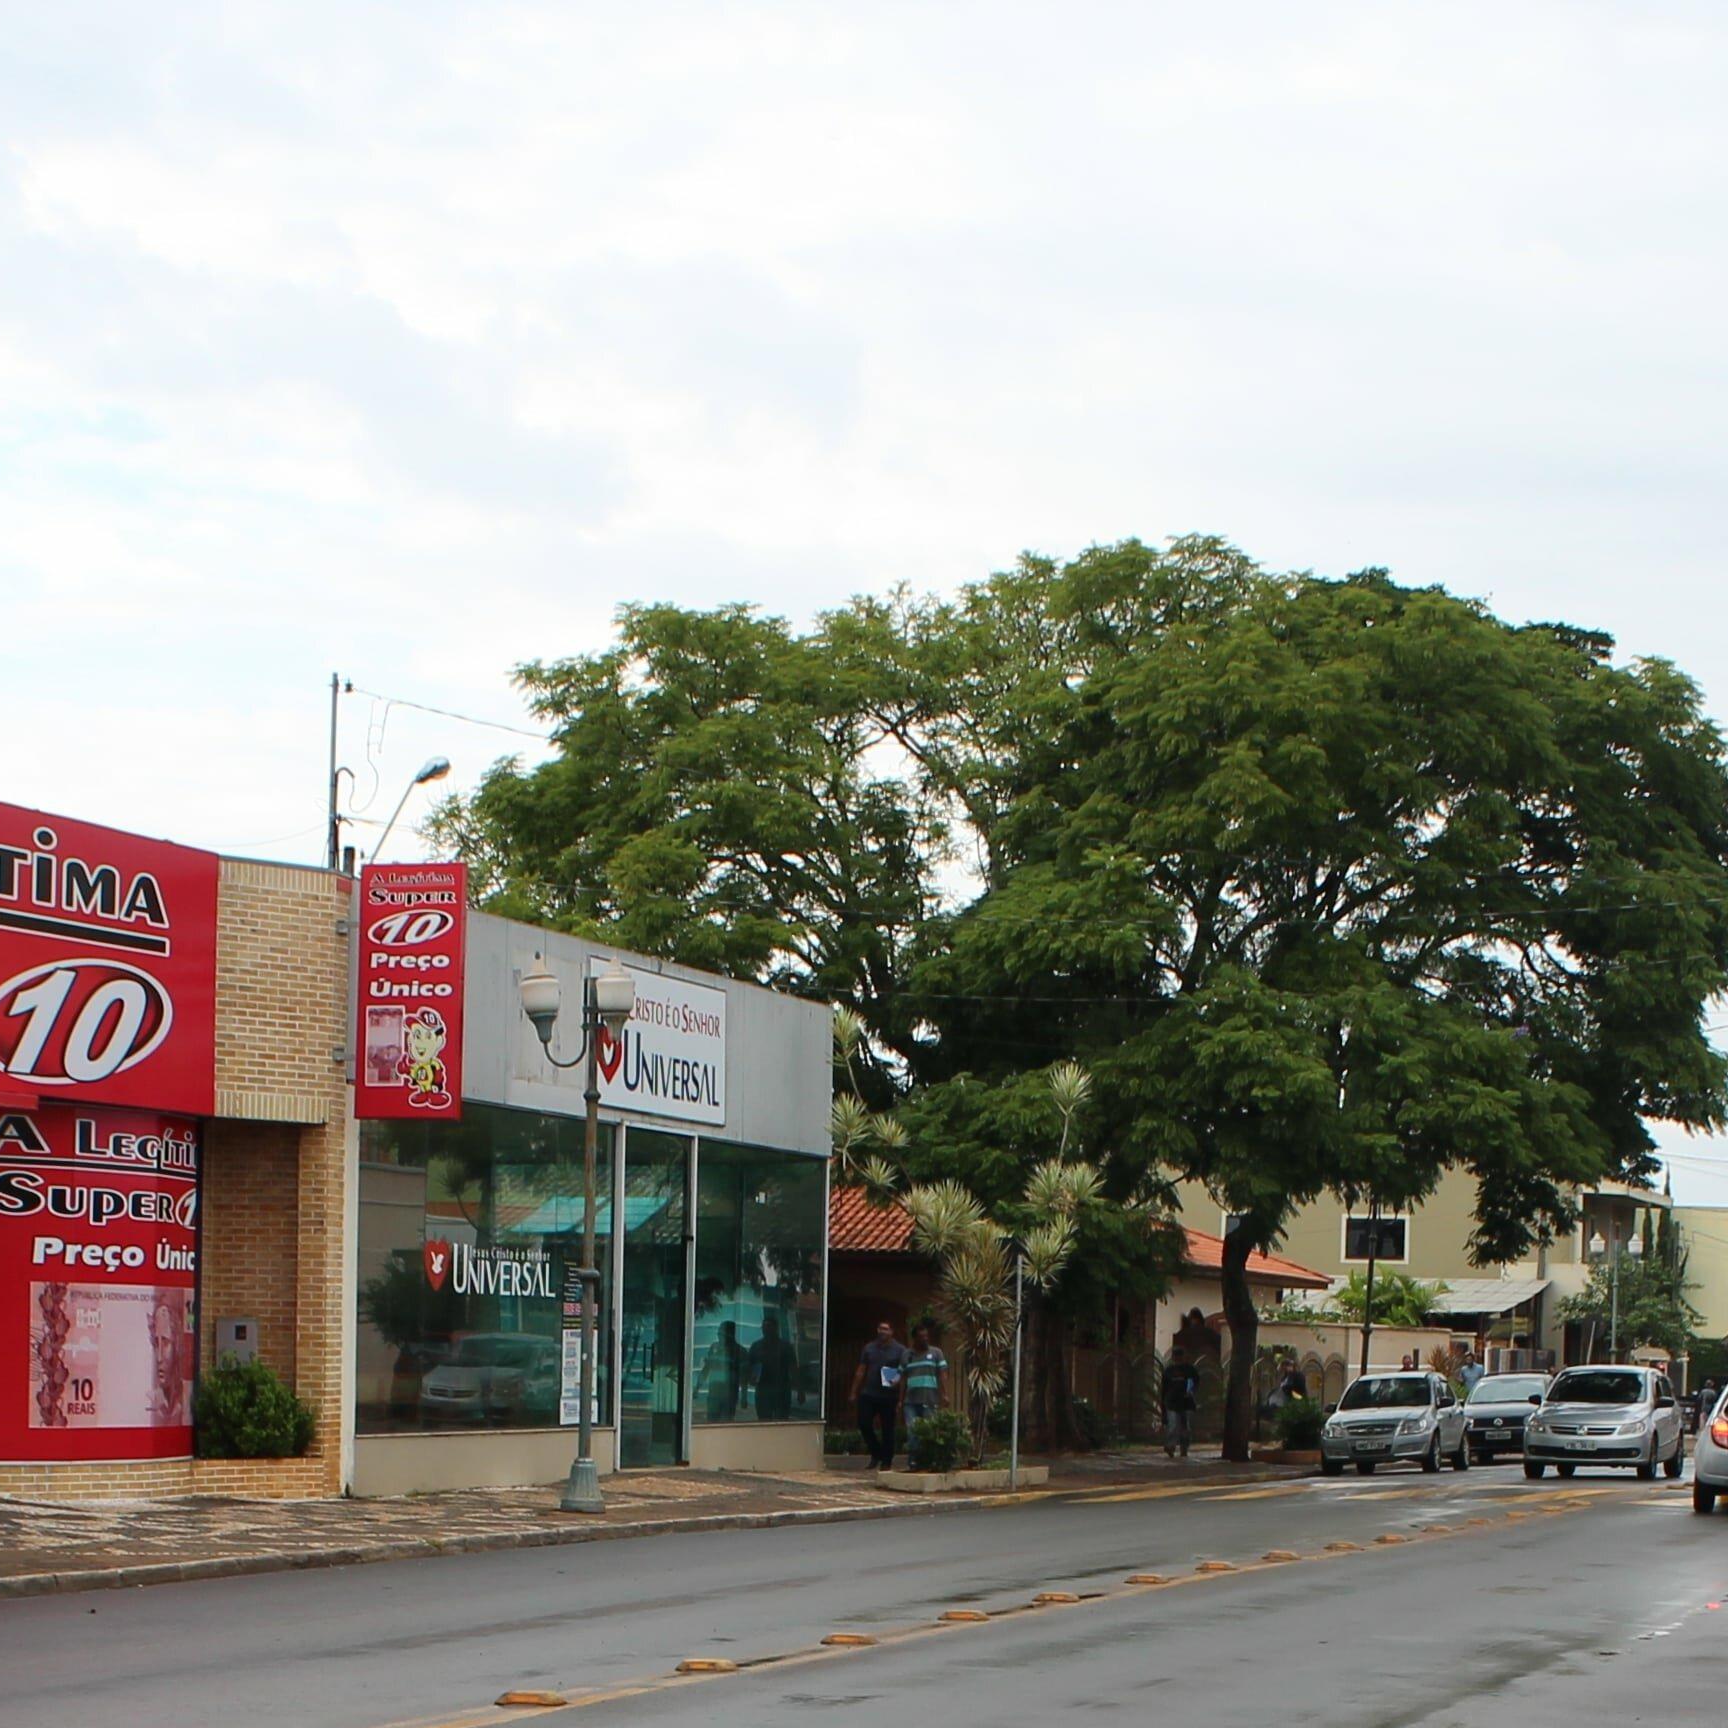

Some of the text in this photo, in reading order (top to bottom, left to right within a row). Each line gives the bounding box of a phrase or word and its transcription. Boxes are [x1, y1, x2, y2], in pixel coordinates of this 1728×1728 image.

[380, 913, 443, 945] 10
[370, 951, 451, 972] Preço
[370, 976, 454, 998] Único
[5, 967, 149, 1083] 10
[681, 1004, 721, 1039] SENHOR
[623, 1029, 720, 1107] UNIVERSAL
[32, 1236, 196, 1273] Preço Únic
[452, 1243, 557, 1299] UNIVERSAL
[71, 1378, 94, 1402] 10
[67, 1402, 96, 1415] REAIS
